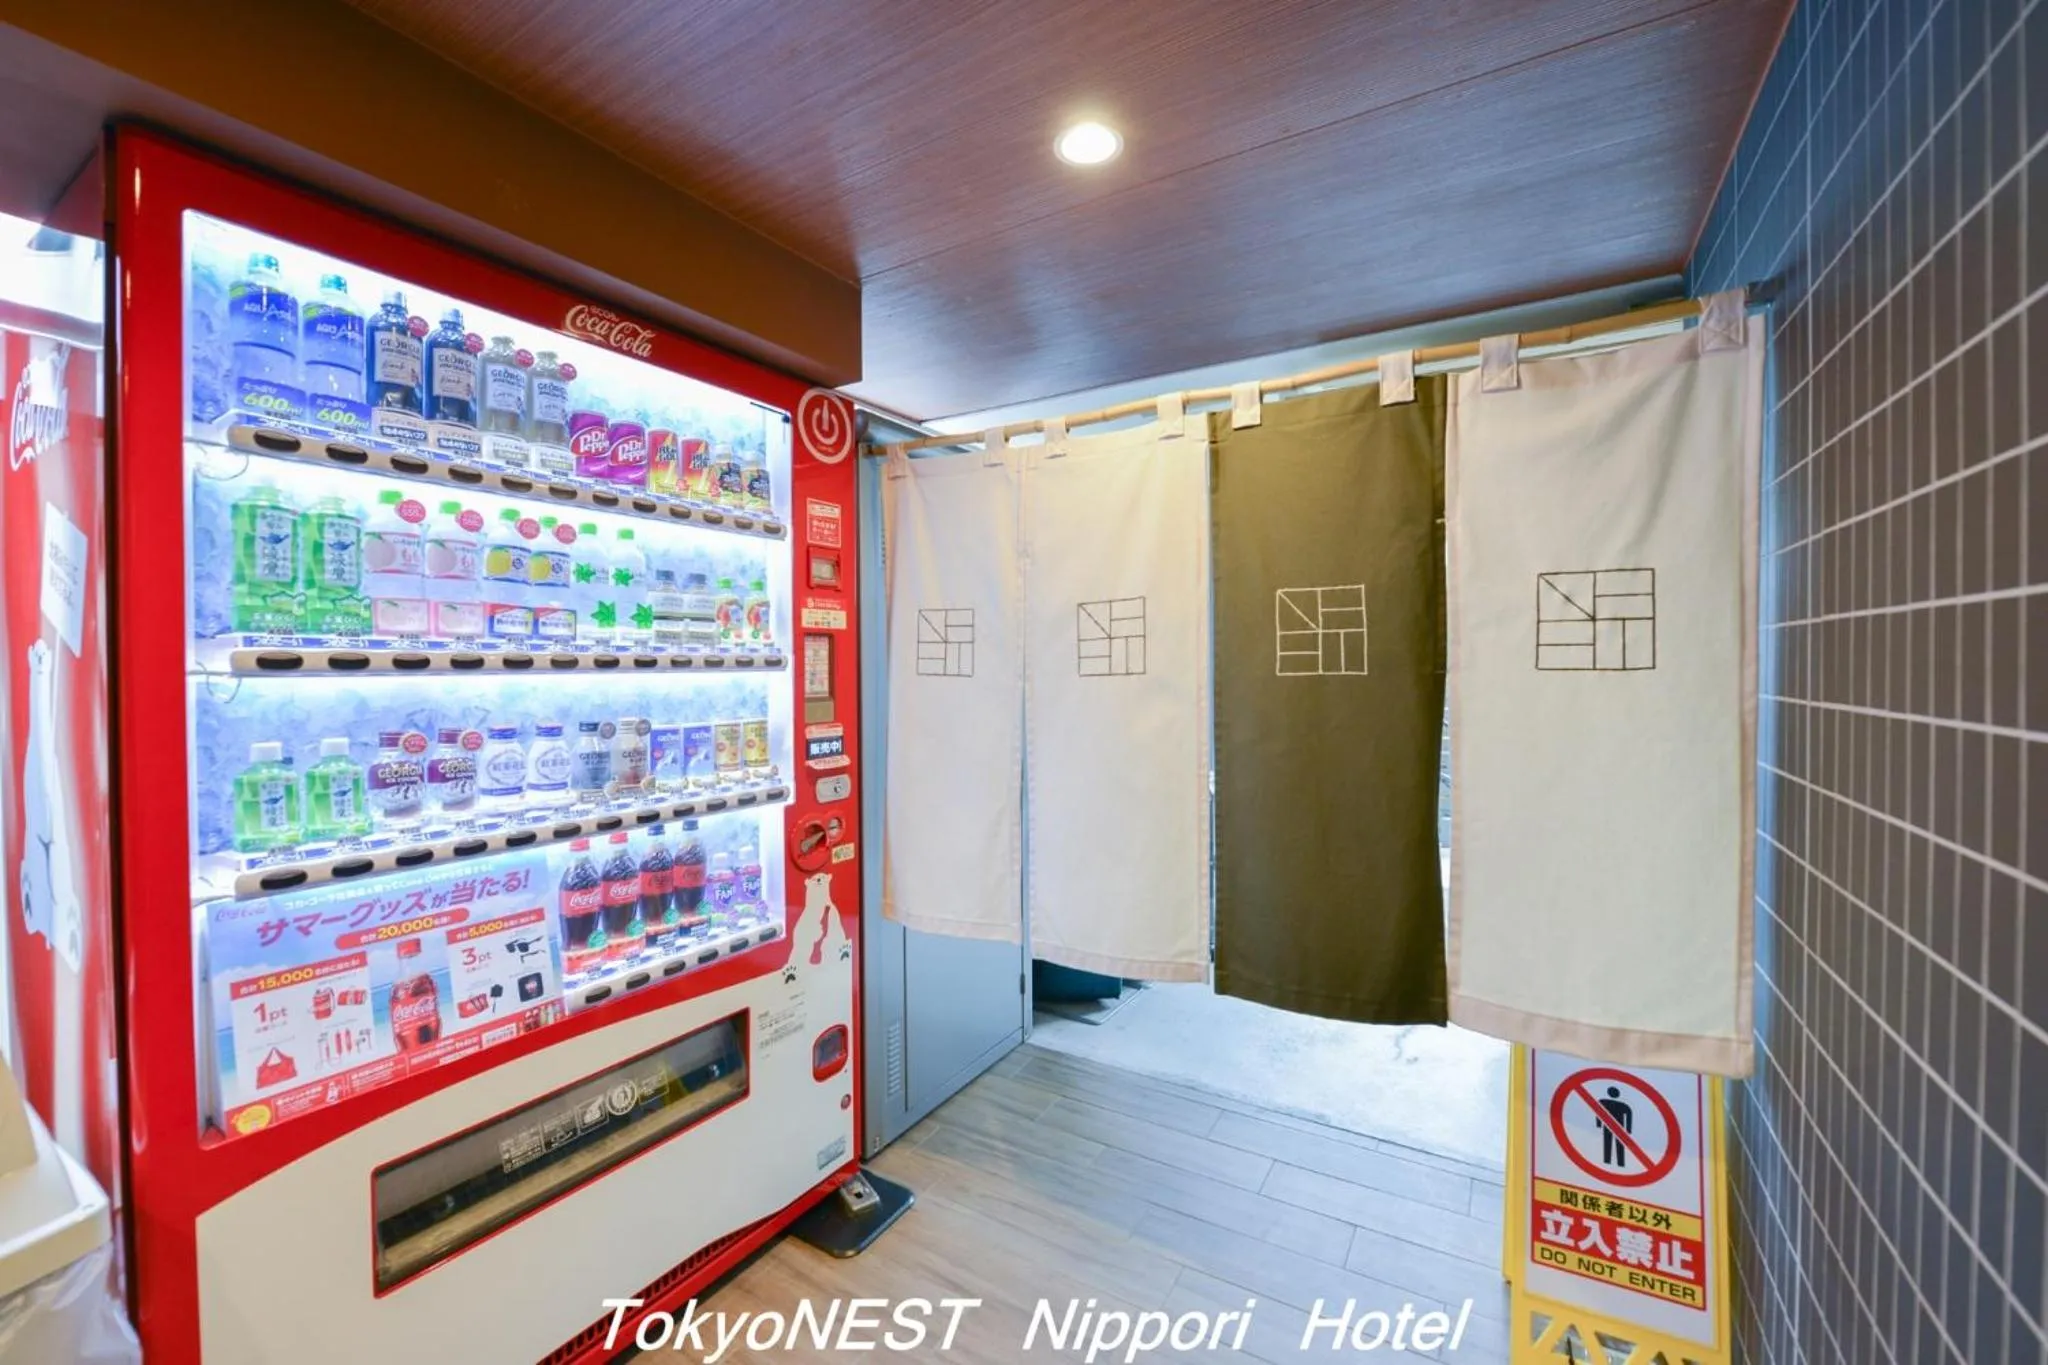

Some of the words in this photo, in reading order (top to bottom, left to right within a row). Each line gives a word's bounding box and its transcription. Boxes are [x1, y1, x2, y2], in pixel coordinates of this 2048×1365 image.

[565, 304, 656, 358] Coca-Cola
[579, 434, 610, 455] Peppe
[617, 442, 648, 462] Pepp
[378, 764, 421, 779] GEORGI
[1560, 1188, 1673, 1231] 関係者以外
[1540, 1209, 1695, 1280] 立入禁止
[1540, 1246, 1567, 1265] DO
[1577, 1256, 1618, 1279] NOT
[1628, 1271, 1697, 1302] ENTER
